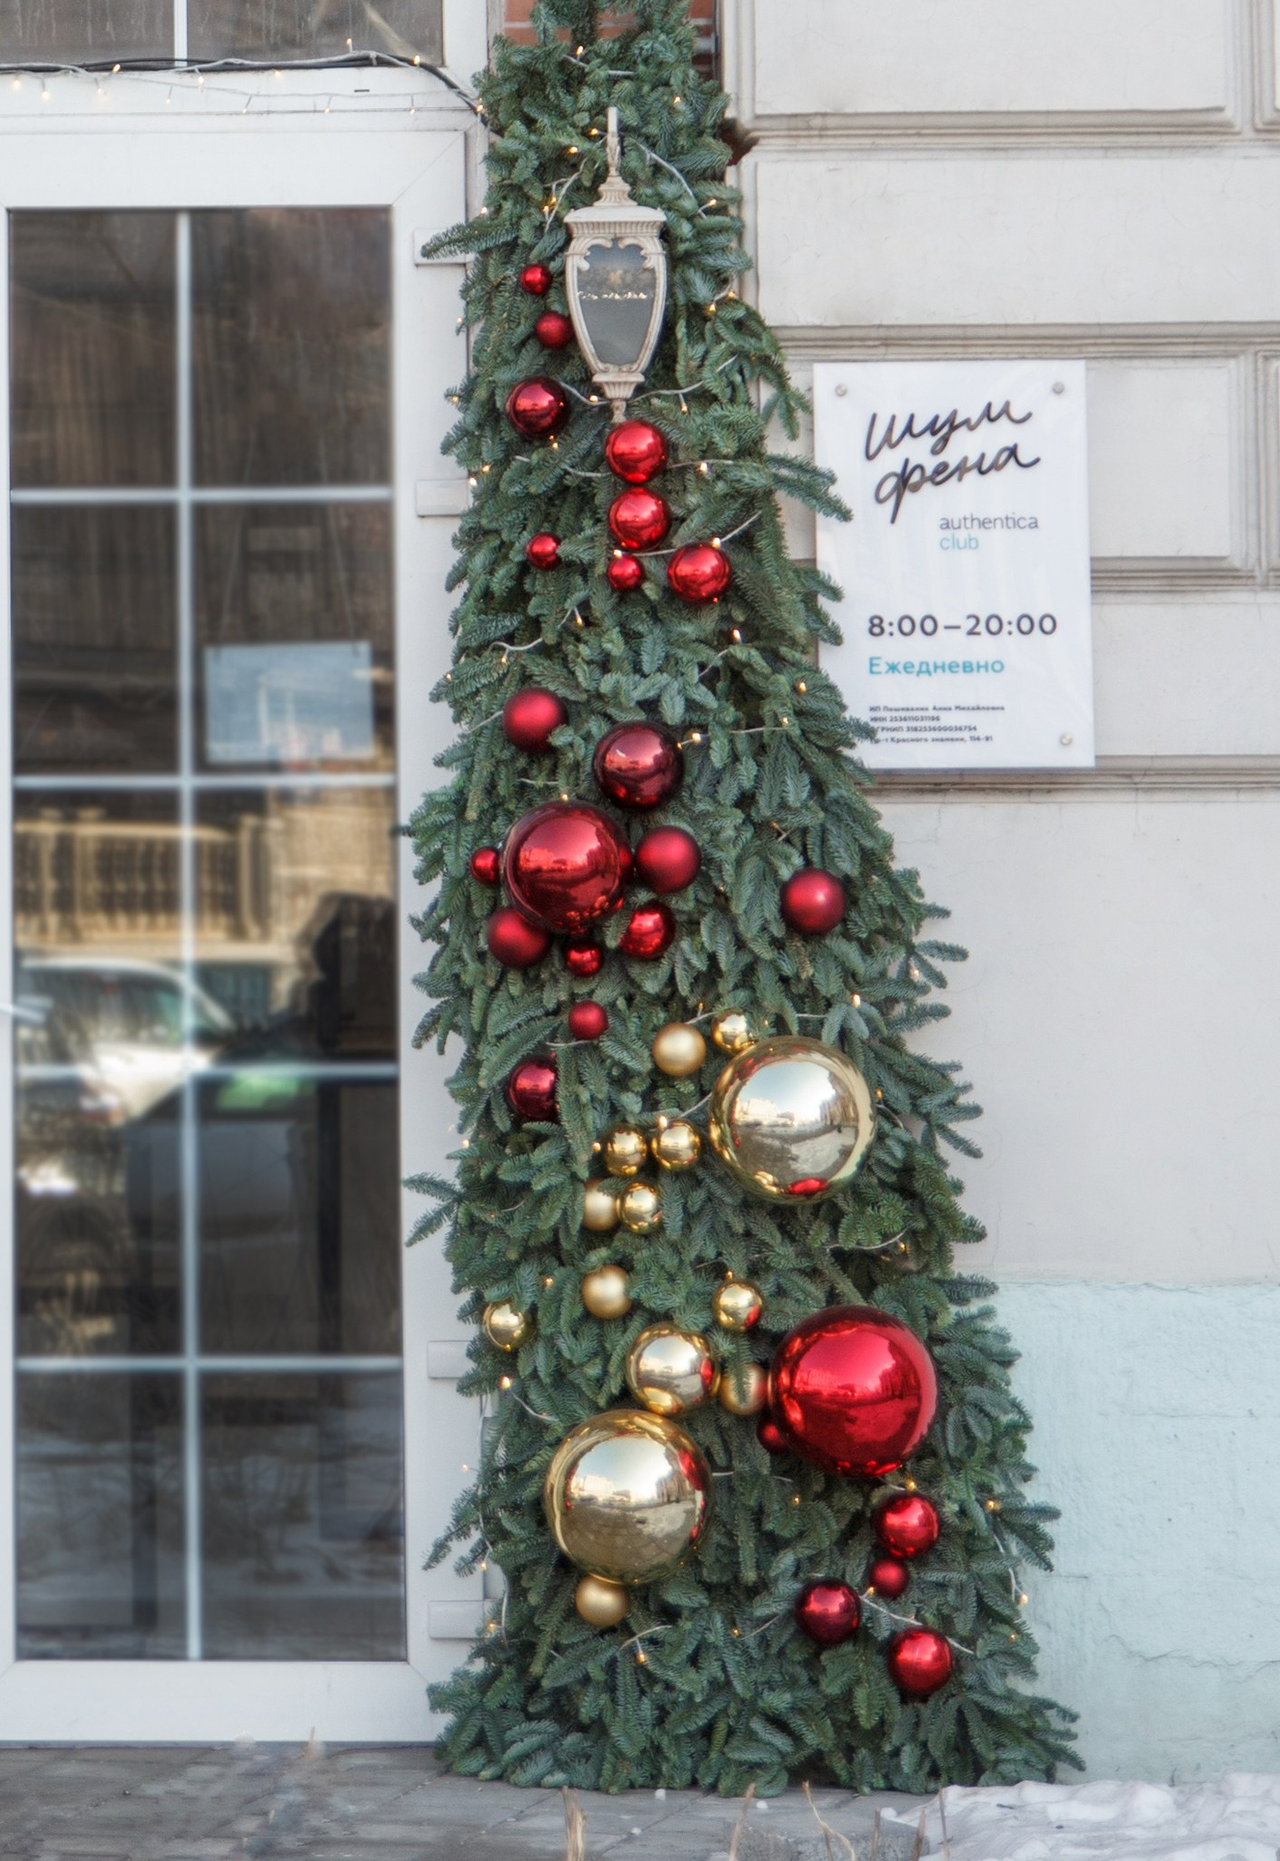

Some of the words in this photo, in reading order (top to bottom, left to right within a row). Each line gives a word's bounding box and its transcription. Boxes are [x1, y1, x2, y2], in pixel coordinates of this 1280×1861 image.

[939, 512, 1039, 531] authentica
[939, 534, 979, 551] club
[869, 656, 1005, 677] Ежедневно
[954, 703, 1005, 711] Михайловна
